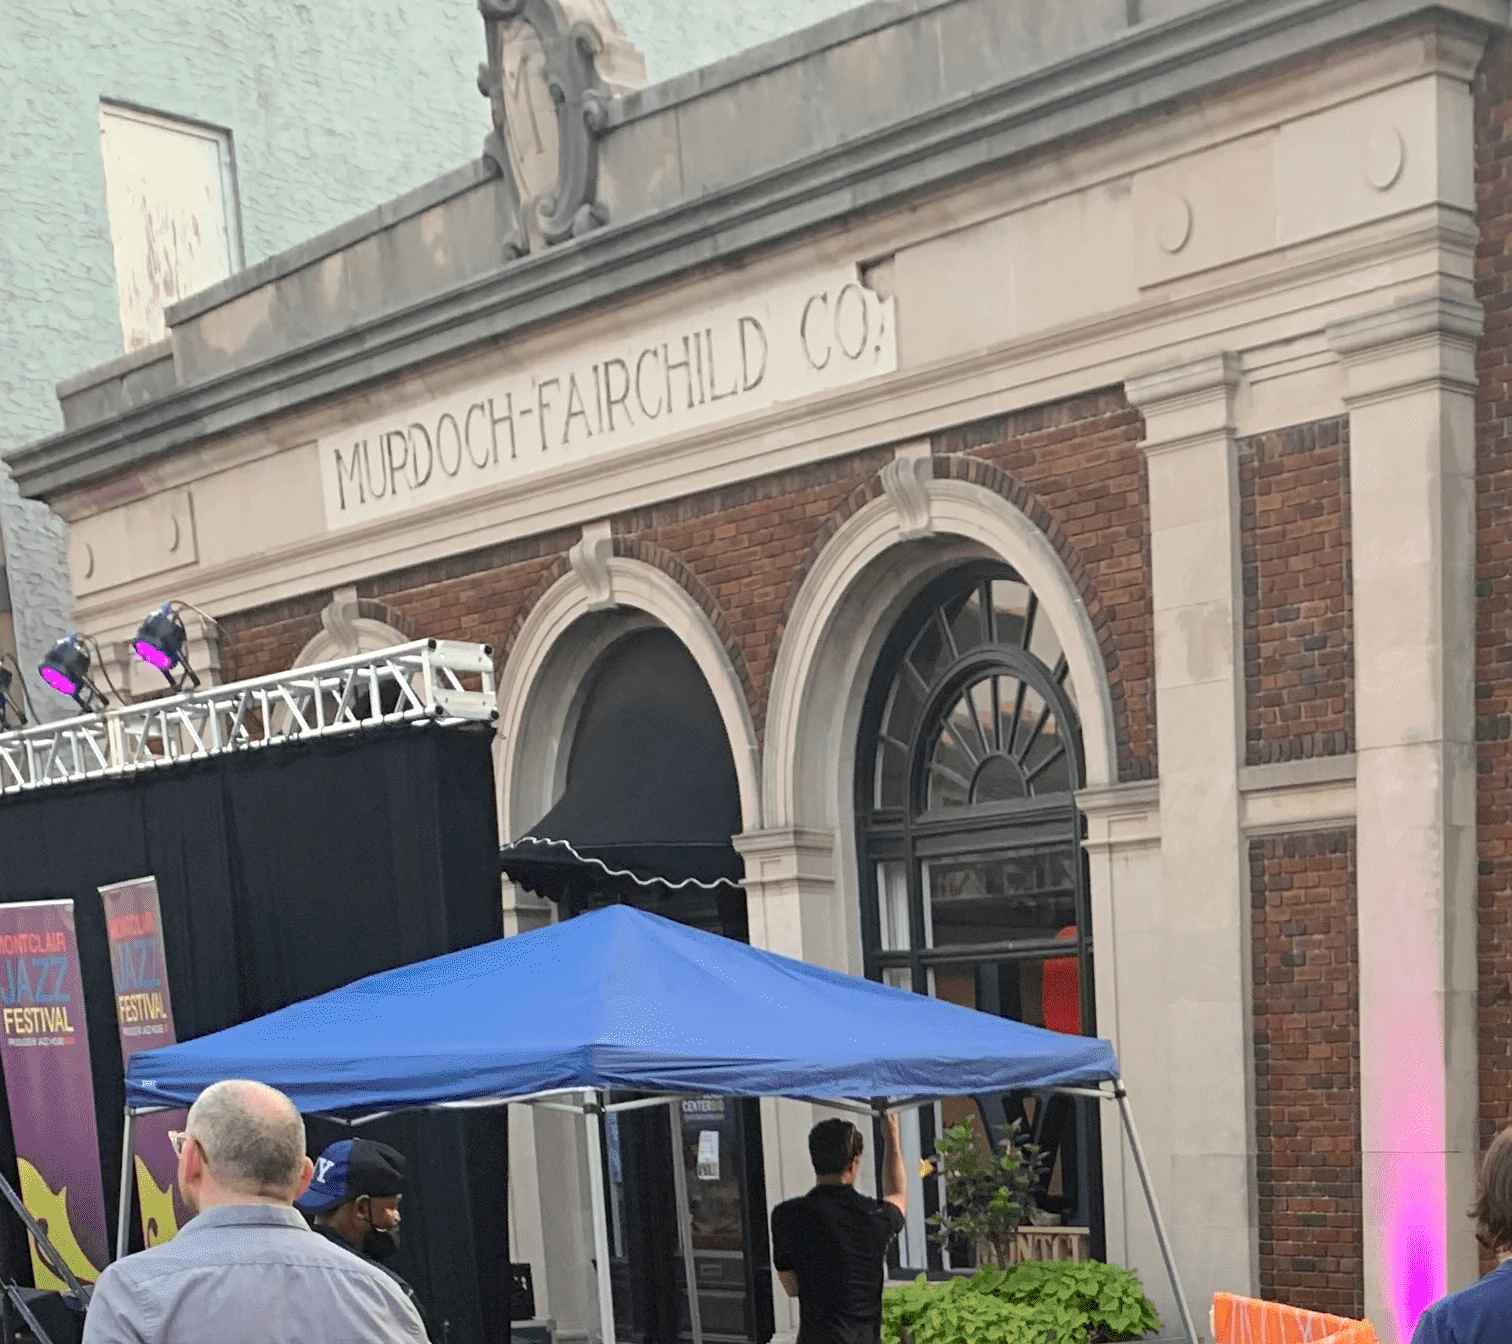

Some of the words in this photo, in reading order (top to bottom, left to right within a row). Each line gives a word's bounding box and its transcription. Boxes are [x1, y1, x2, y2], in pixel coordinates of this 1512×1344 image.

[334, 315, 768, 509] MURDOCH-FAIRCHILD
[0, 955, 71, 1006] JAZZ
[3, 1006, 74, 1033] FESTIVAL
[117, 991, 168, 1023] FESTIVAL
